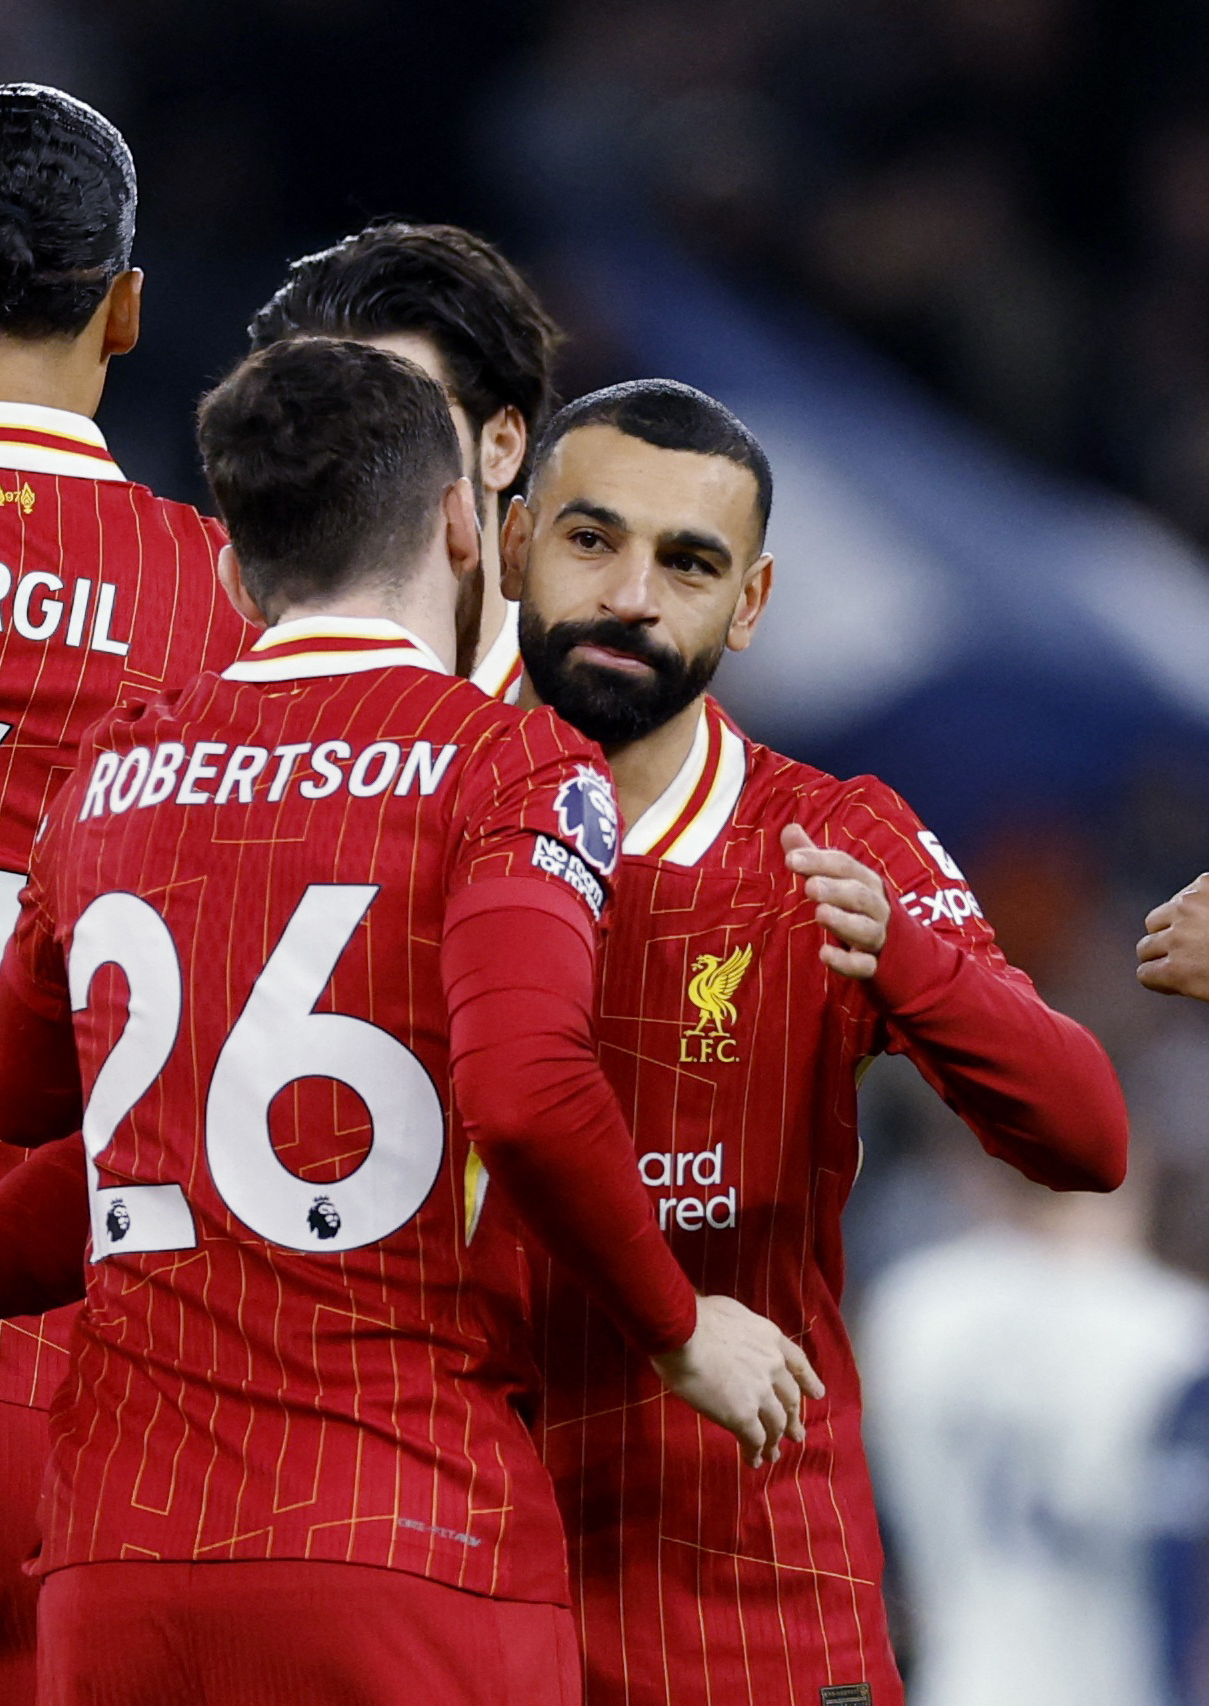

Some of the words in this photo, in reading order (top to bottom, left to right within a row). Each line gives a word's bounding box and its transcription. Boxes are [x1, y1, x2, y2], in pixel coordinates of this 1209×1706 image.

[5, 491, 21, 503] 97
[79, 741, 458, 822] ROBERTSON
[535, 834, 568, 863] No
[568, 854, 604, 907] room
[679, 1038, 739, 1063] L.F.C.
[68, 884, 446, 1266] 26
[637, 1141, 722, 1187] ard
[658, 1185, 736, 1231] red
